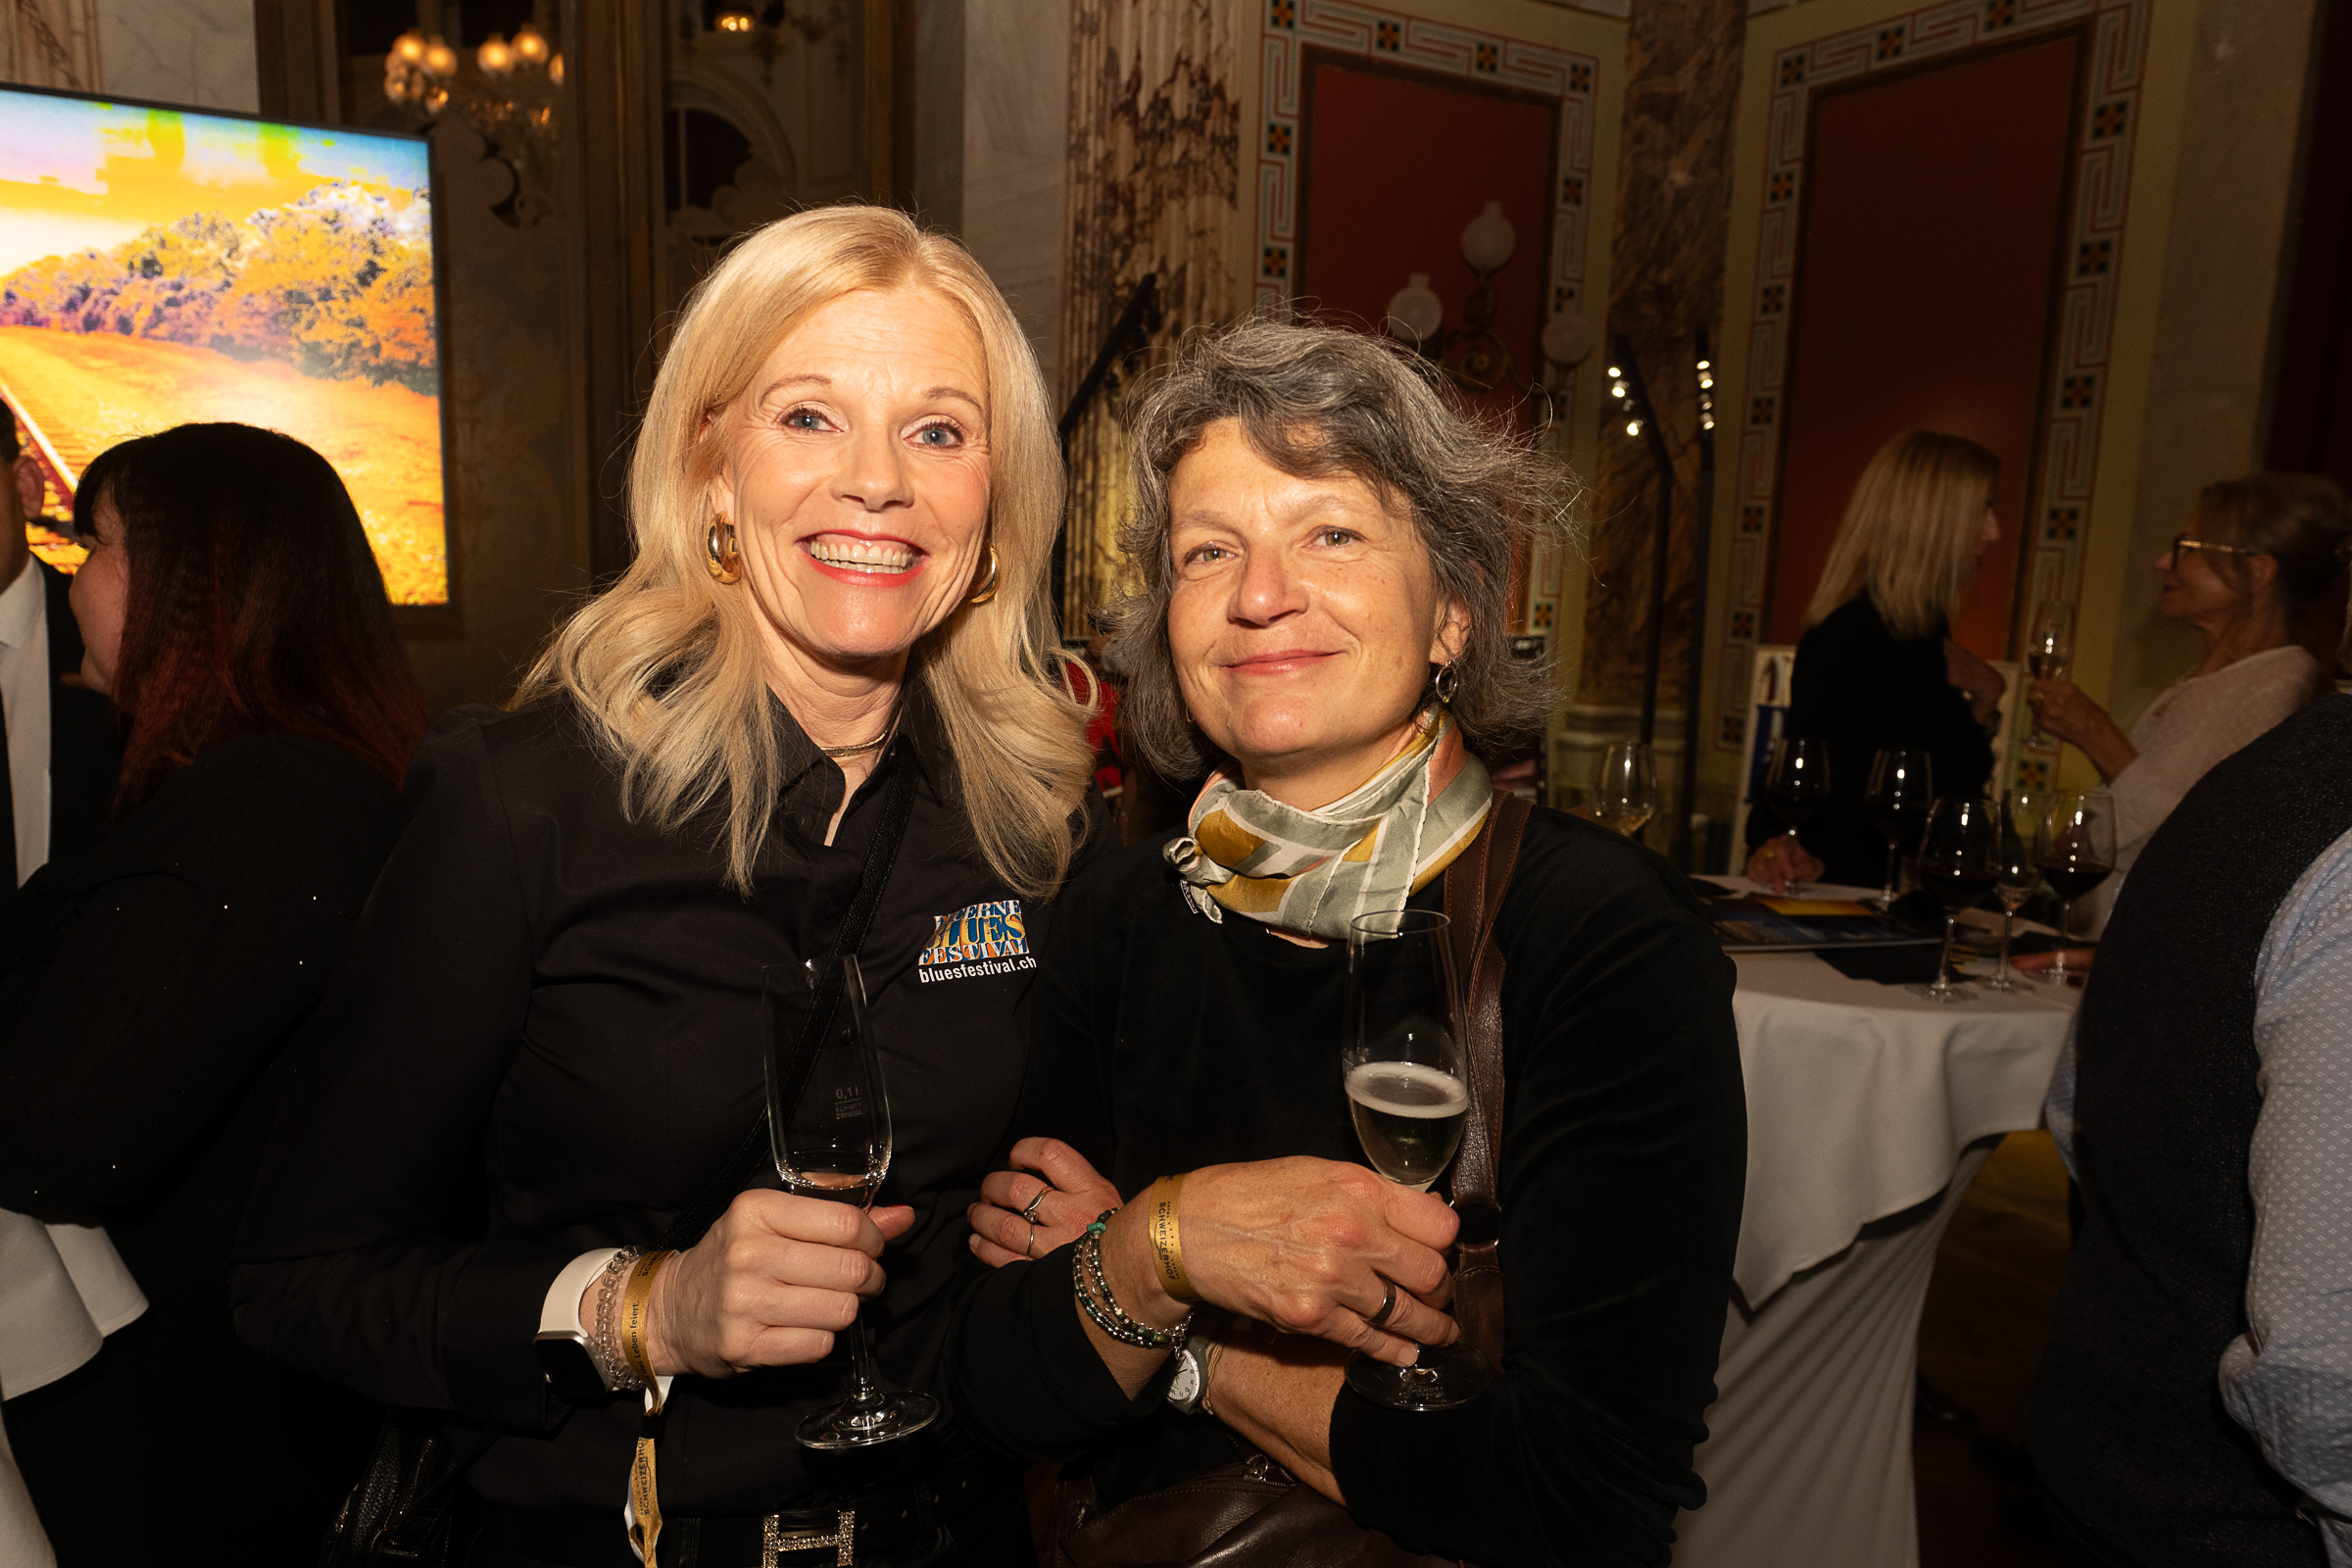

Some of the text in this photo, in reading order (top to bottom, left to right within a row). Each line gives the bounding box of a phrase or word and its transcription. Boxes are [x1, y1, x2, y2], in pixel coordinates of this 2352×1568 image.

[918, 938, 1030, 966] FESTIVAL
[918, 956, 1037, 984] bluesfestival.ch
[1158, 1201, 1175, 1280] SCHWEIZERHOF
[629, 1300, 640, 1329] feiert.
[630, 1332, 641, 1358] Leben
